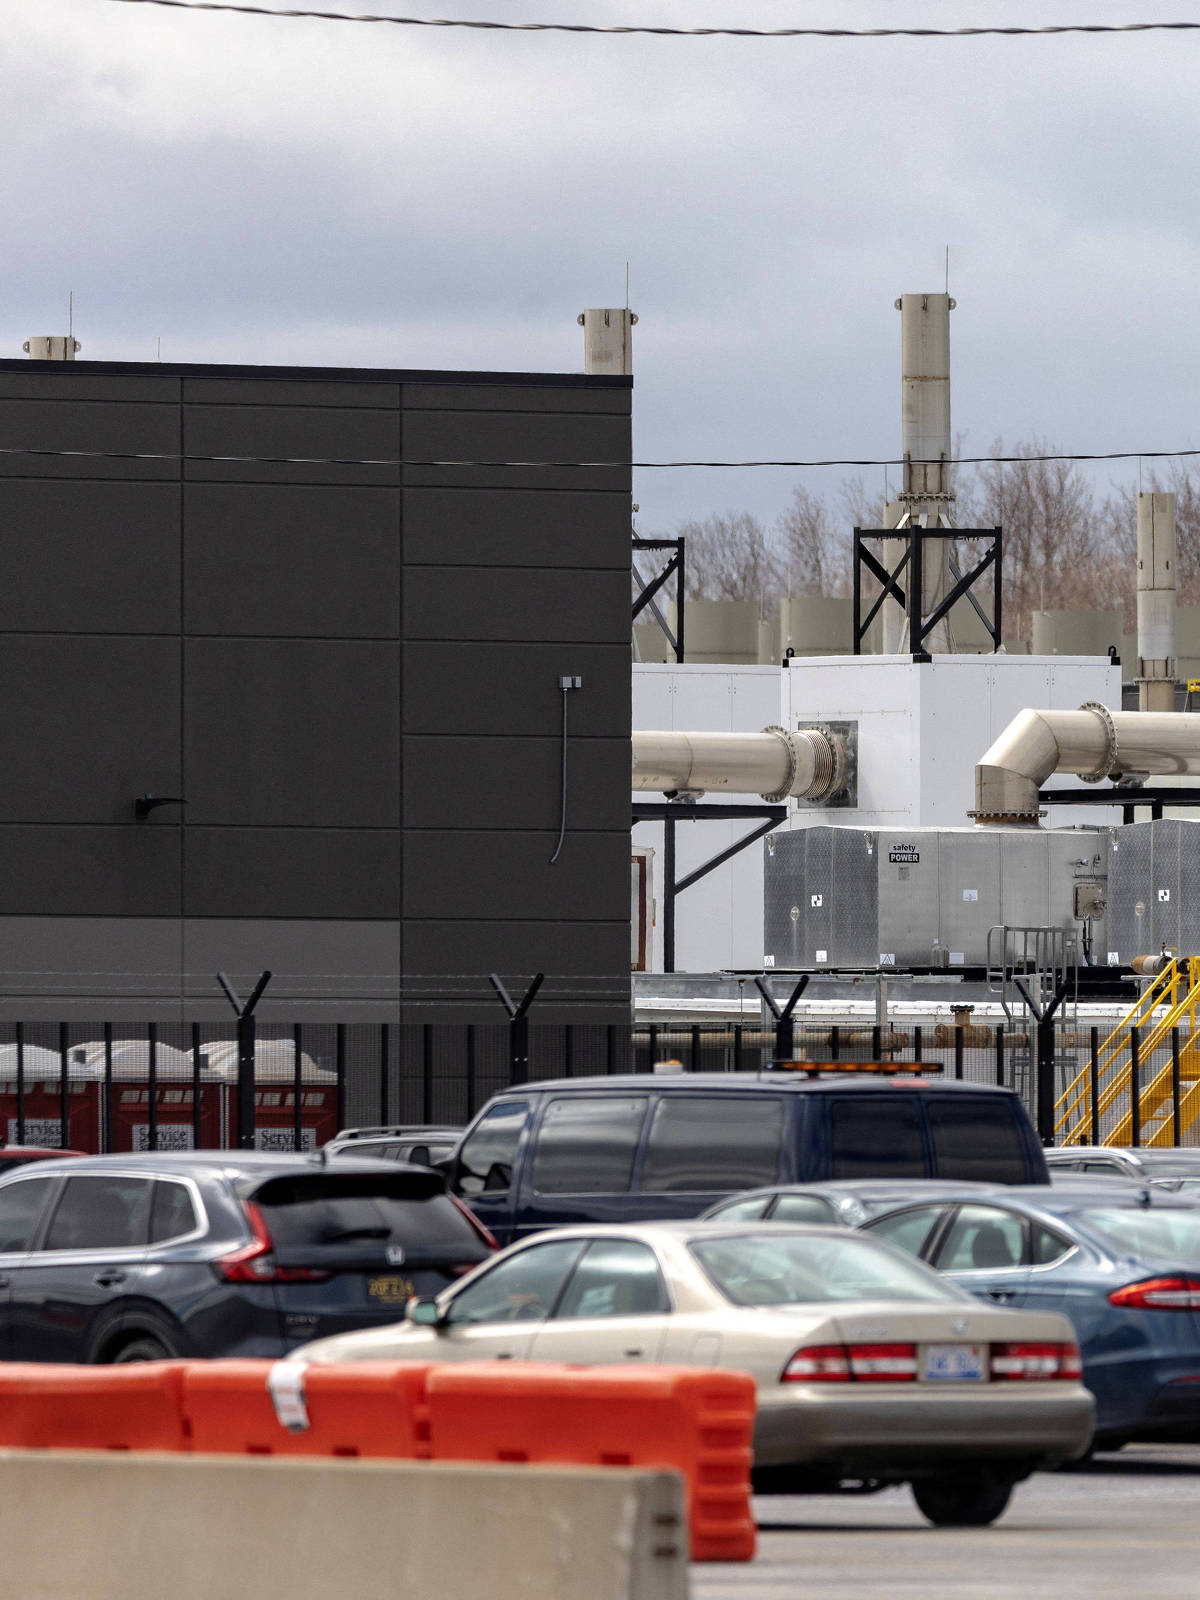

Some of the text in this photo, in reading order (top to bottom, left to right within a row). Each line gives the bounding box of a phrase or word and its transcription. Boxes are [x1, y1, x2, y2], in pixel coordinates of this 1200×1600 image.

[893, 844, 915, 852] safety
[890, 853, 919, 862] POWER
[17, 1120, 62, 1135] ervice
[139, 1126, 187, 1142] Srvice
